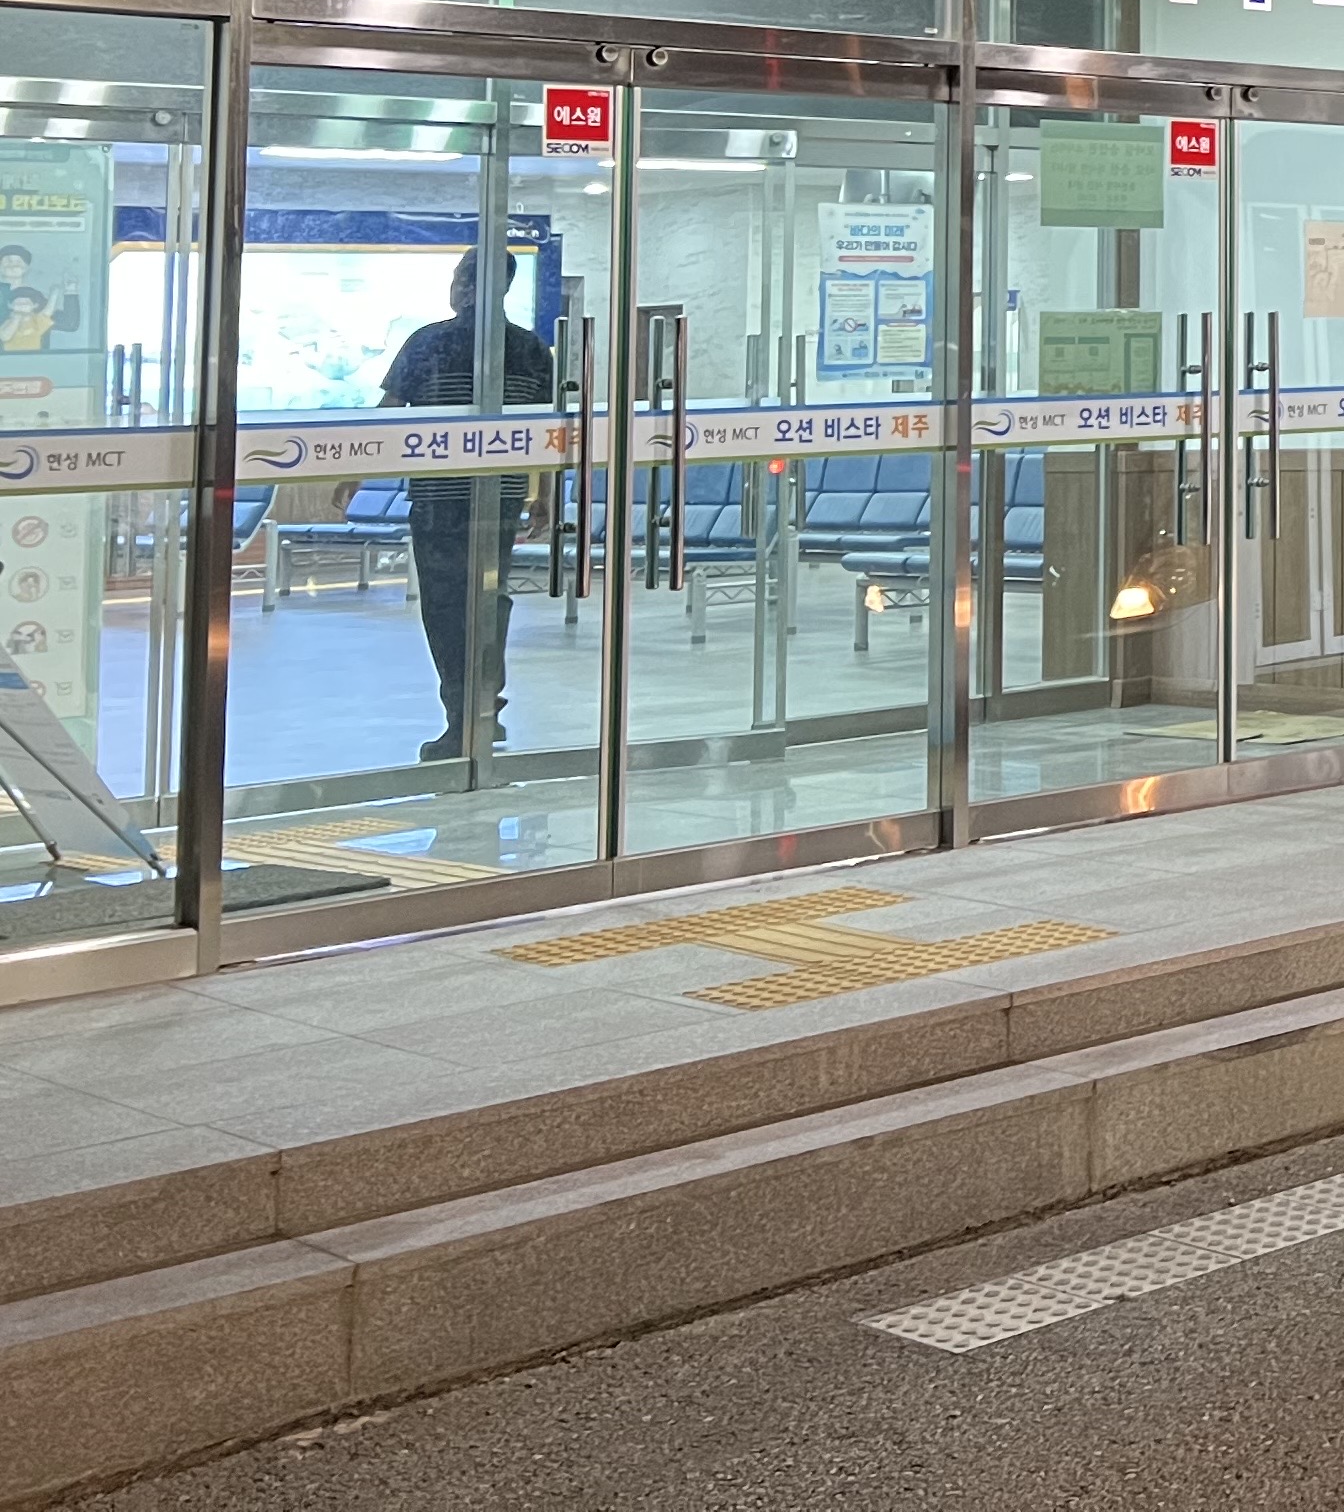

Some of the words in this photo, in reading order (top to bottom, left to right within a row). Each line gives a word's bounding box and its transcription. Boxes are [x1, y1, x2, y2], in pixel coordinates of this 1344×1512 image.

[553, 106, 602, 127] 에스원
[546, 143, 590, 155] SECOM
[1175, 136, 1210, 154] 에스원
[1043, 413, 1067, 427] MCT
[1077, 406, 1111, 429] 오션
[1119, 404, 1168, 428] 비스타
[1307, 403, 1328, 416] MCT
[731, 426, 761, 441] MCT
[774, 418, 814, 443] 오션
[824, 416, 881, 440] 비스타
[891, 414, 929, 439] 제주
[314, 442, 343, 460] 현성
[349, 440, 384, 457] MCT
[401, 430, 449, 459] 오션
[462, 427, 533, 457] 비스타
[46, 452, 79, 472] 현성
[85, 450, 125, 468] MCT
